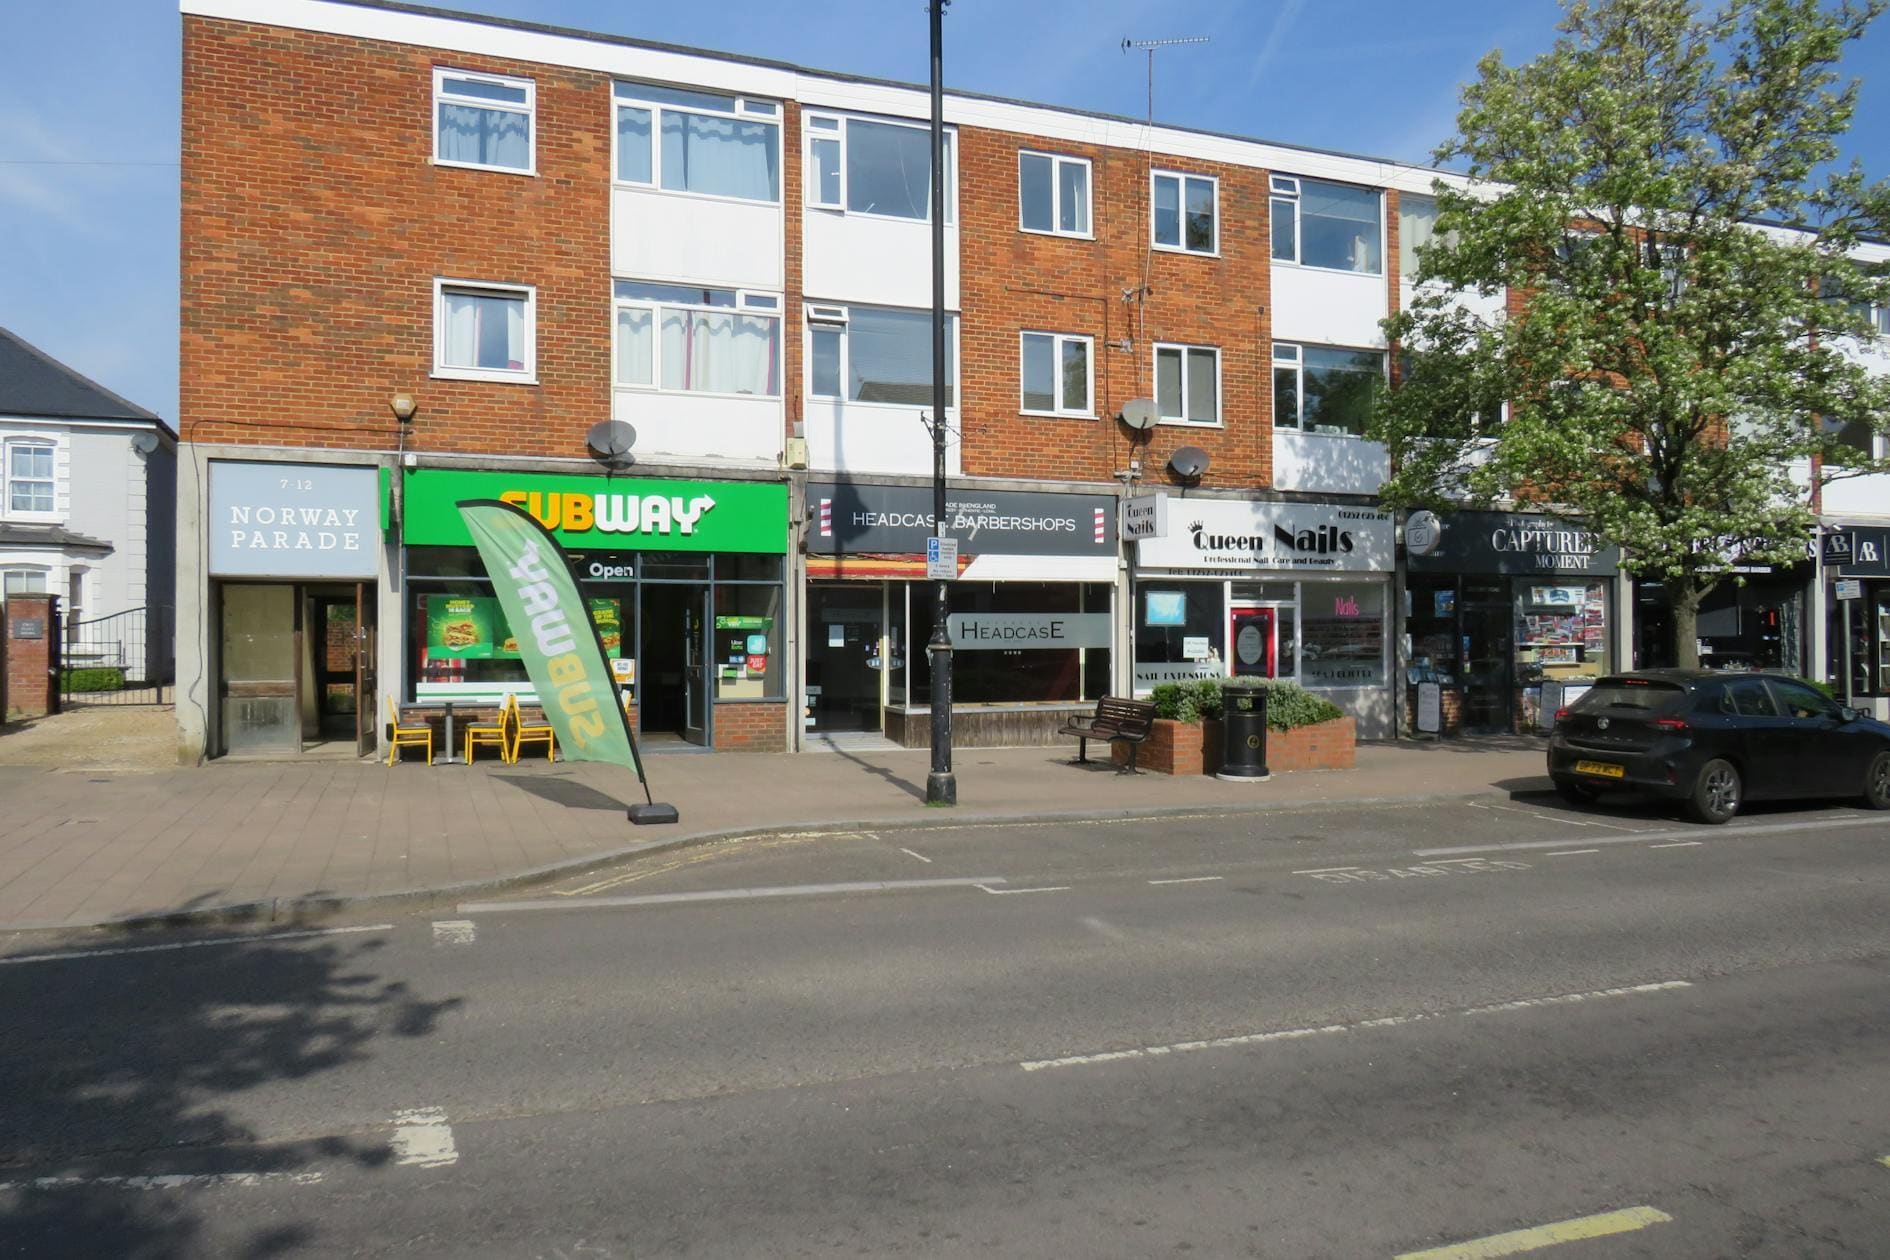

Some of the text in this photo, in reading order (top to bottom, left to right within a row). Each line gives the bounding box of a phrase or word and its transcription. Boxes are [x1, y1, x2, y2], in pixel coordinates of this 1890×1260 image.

[231, 506, 360, 527] NORWAY
[852, 512, 1076, 532] HEADCAS BARBERSHOPS
[1127, 520, 1154, 535] Nails
[231, 531, 360, 550] PARADE
[1193, 524, 1353, 554] Queen Nails
[1204, 556, 1251, 564] Professional
[1536, 555, 1590, 569] MOMENT
[589, 562, 634, 580] Open
[1335, 595, 1360, 616] Nails
[961, 621, 1065, 640] HEADCASE
[1136, 672, 1158, 680] NAIL
